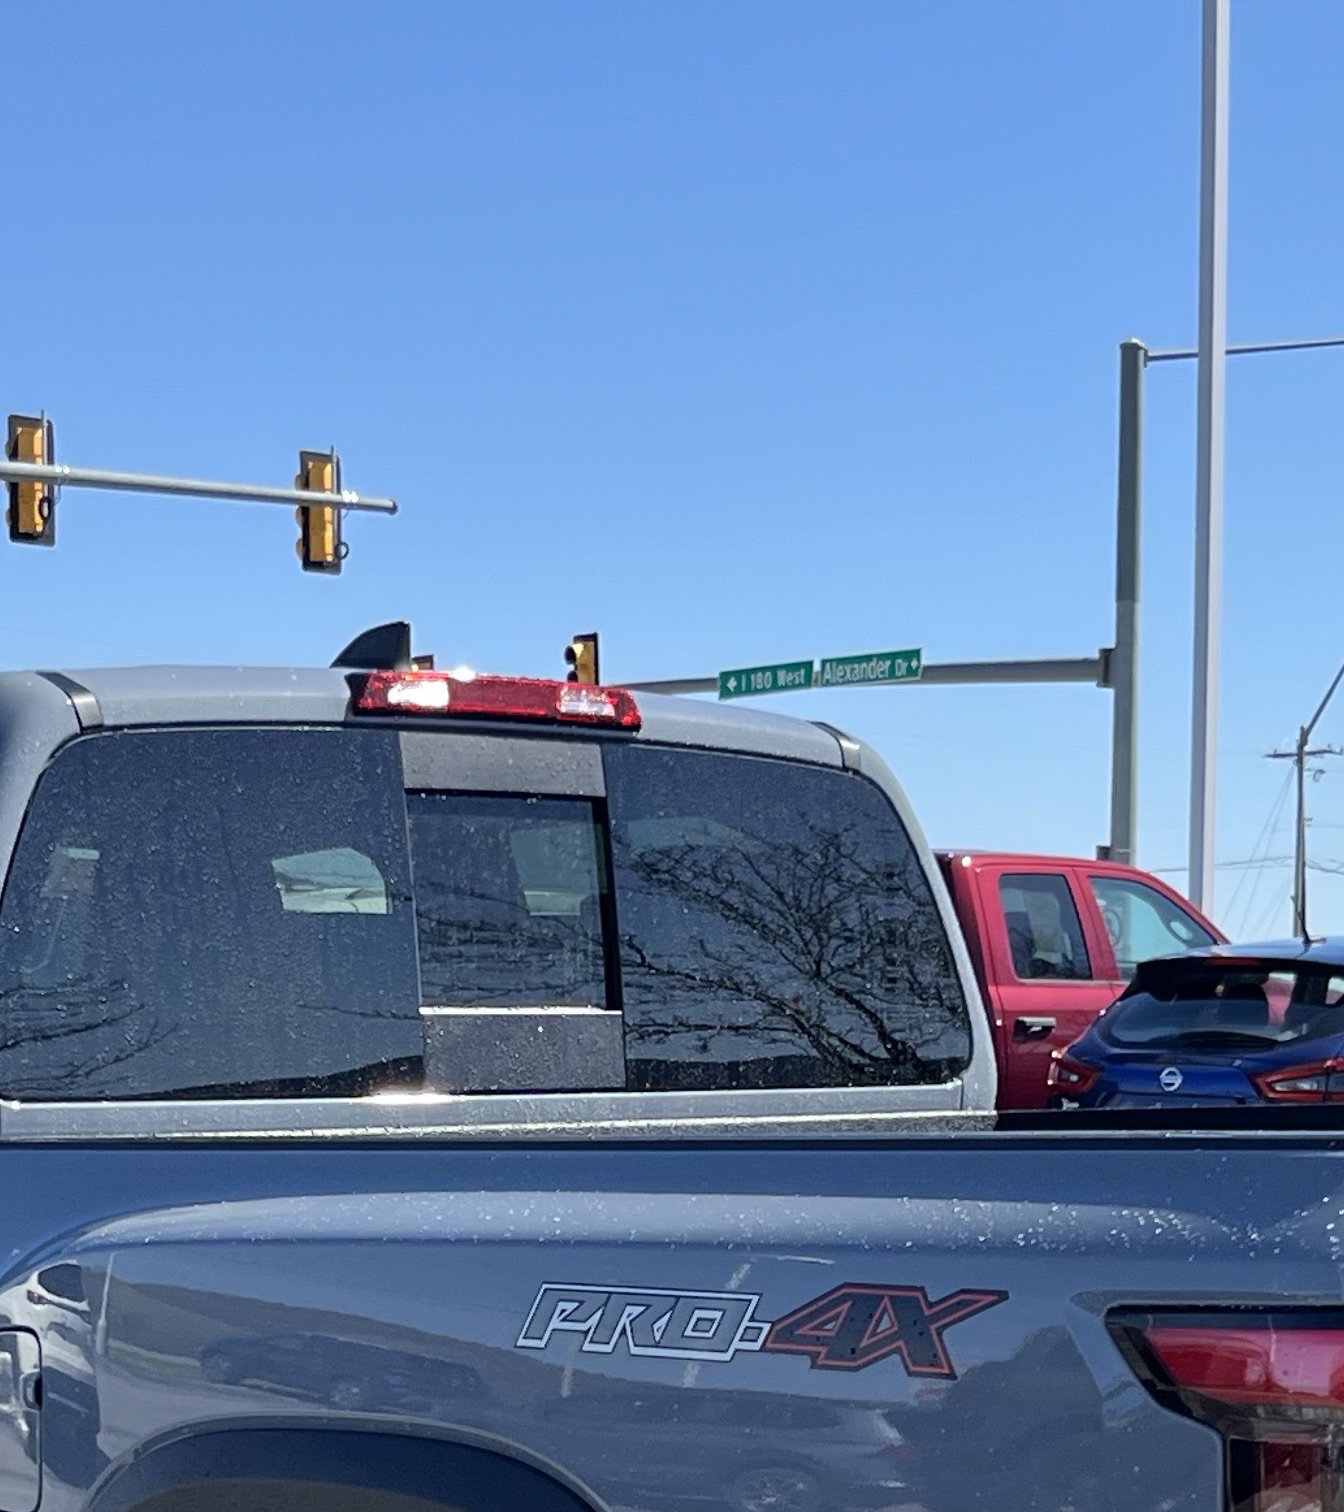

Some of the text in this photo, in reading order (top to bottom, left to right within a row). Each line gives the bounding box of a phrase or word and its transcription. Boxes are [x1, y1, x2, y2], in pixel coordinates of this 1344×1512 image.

[750, 672, 772, 691] 180
[776, 668, 805, 687] West
[822, 658, 909, 686] Alexander Dr
